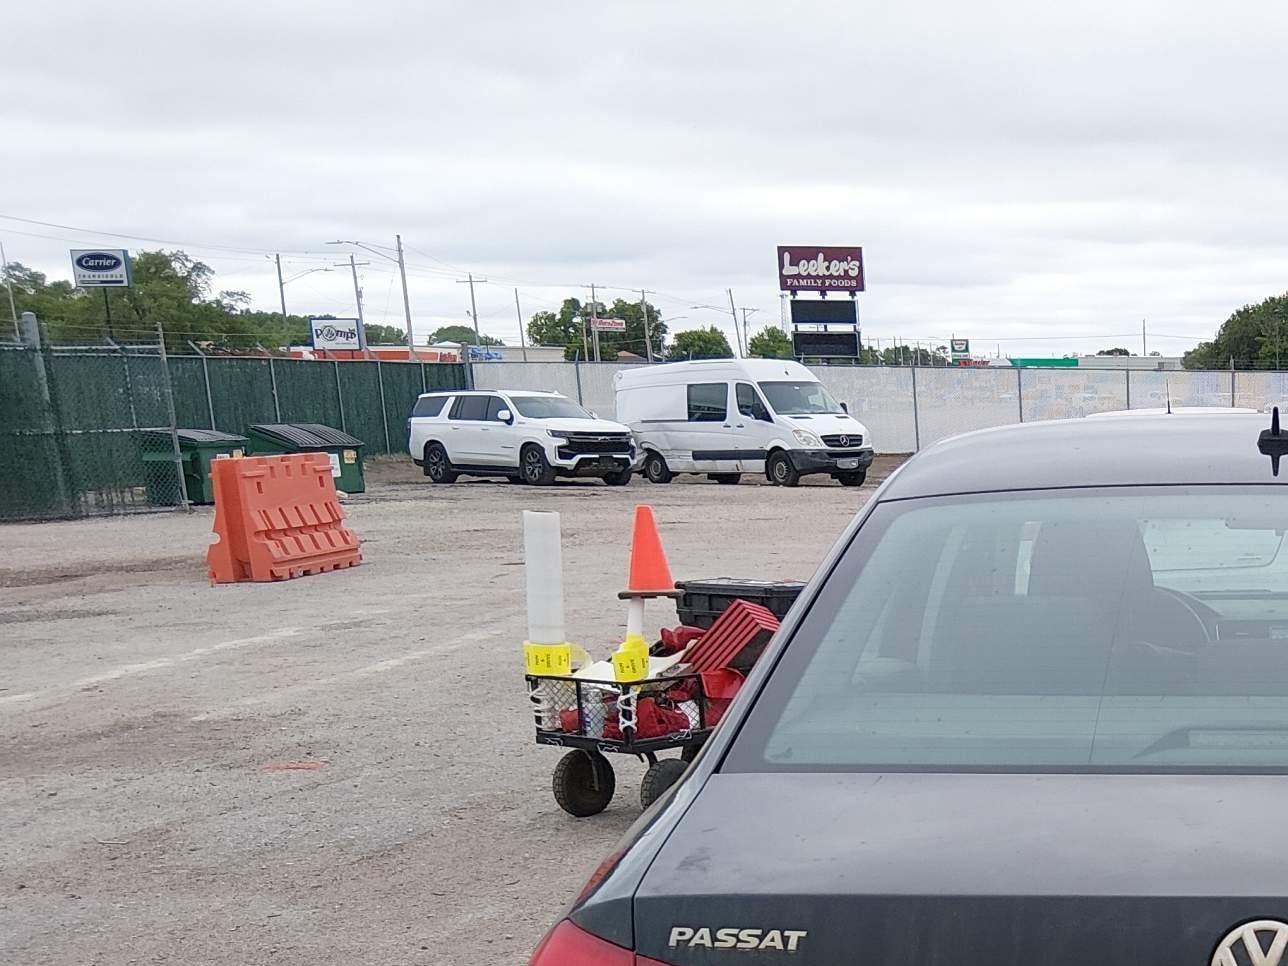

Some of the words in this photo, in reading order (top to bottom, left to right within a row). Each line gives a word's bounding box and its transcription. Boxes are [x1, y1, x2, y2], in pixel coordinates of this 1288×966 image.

[82, 257, 117, 267] Carrier
[782, 251, 860, 277] Leeker's
[786, 279, 822, 287] FAMILY
[825, 279, 857, 287] FOODS
[668, 927, 808, 951] PASSAT
